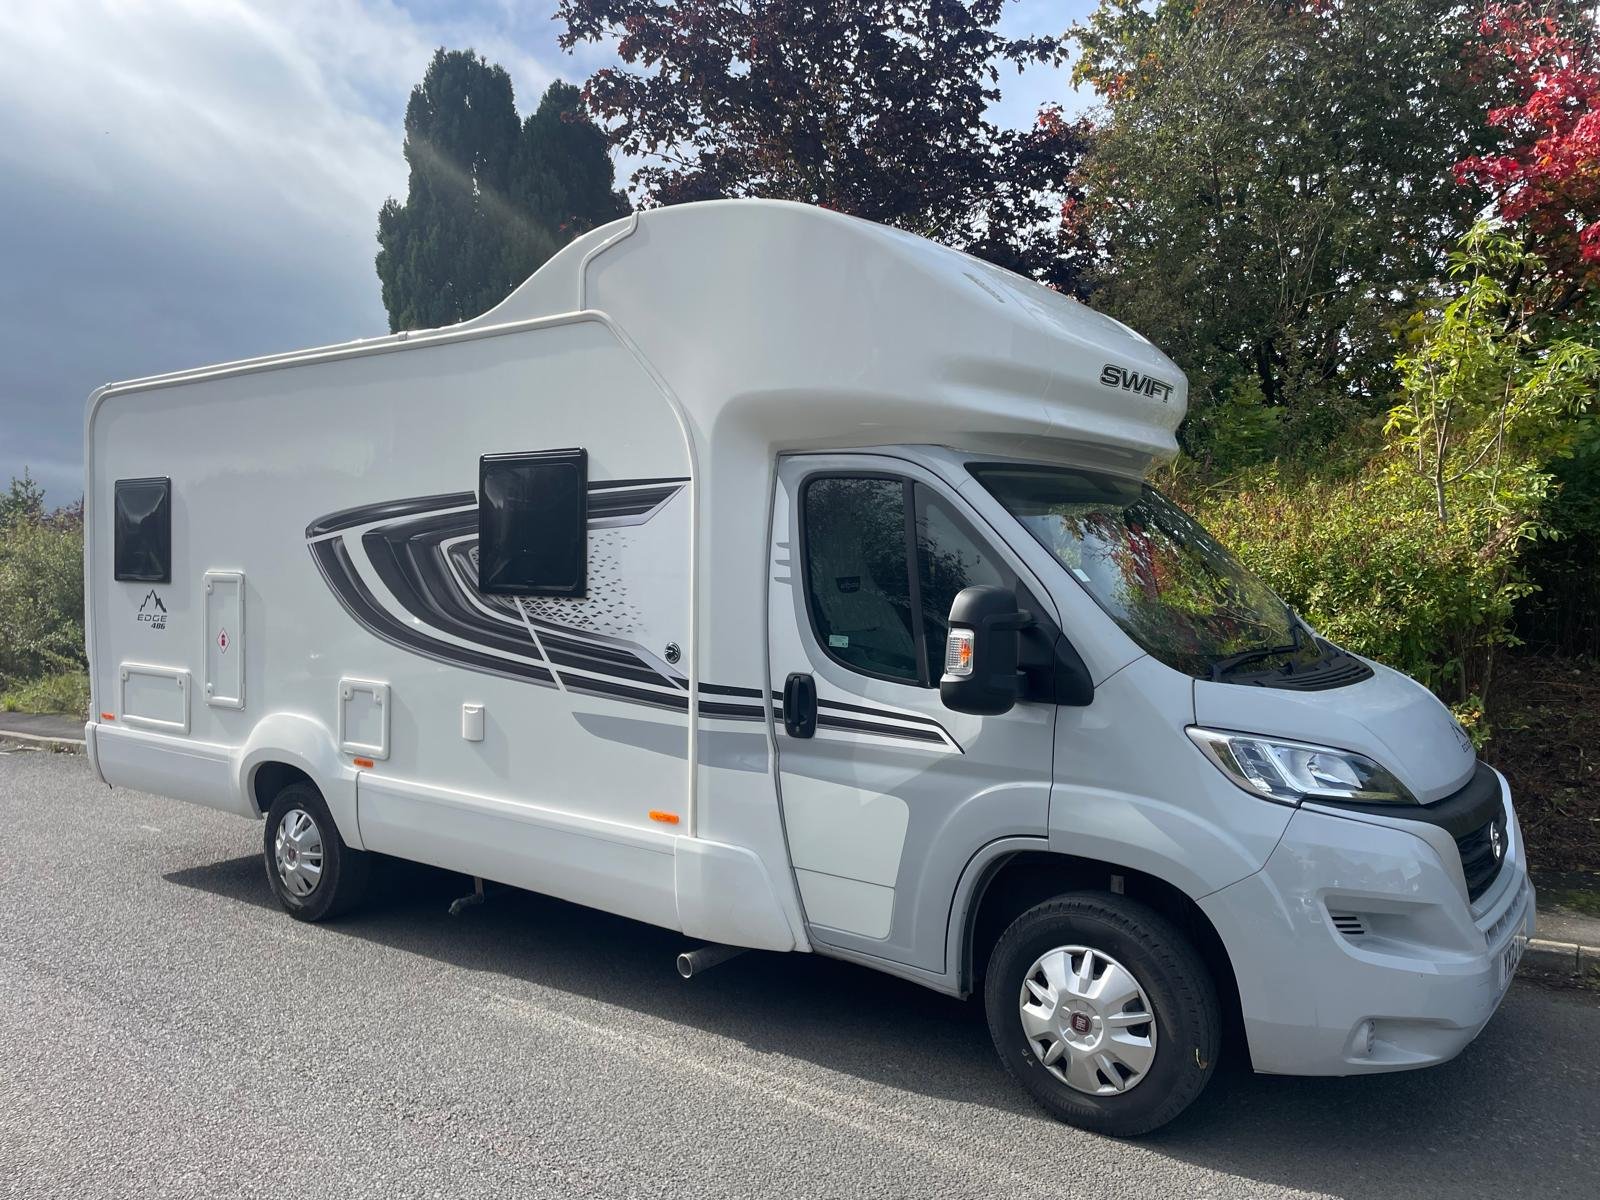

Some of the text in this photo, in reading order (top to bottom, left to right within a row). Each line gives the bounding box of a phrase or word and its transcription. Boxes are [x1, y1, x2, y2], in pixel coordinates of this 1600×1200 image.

[1100, 364, 1174, 403] SWIFT
[137, 614, 167, 622] EDGE
[1075, 1015, 1086, 1031] FIAT
